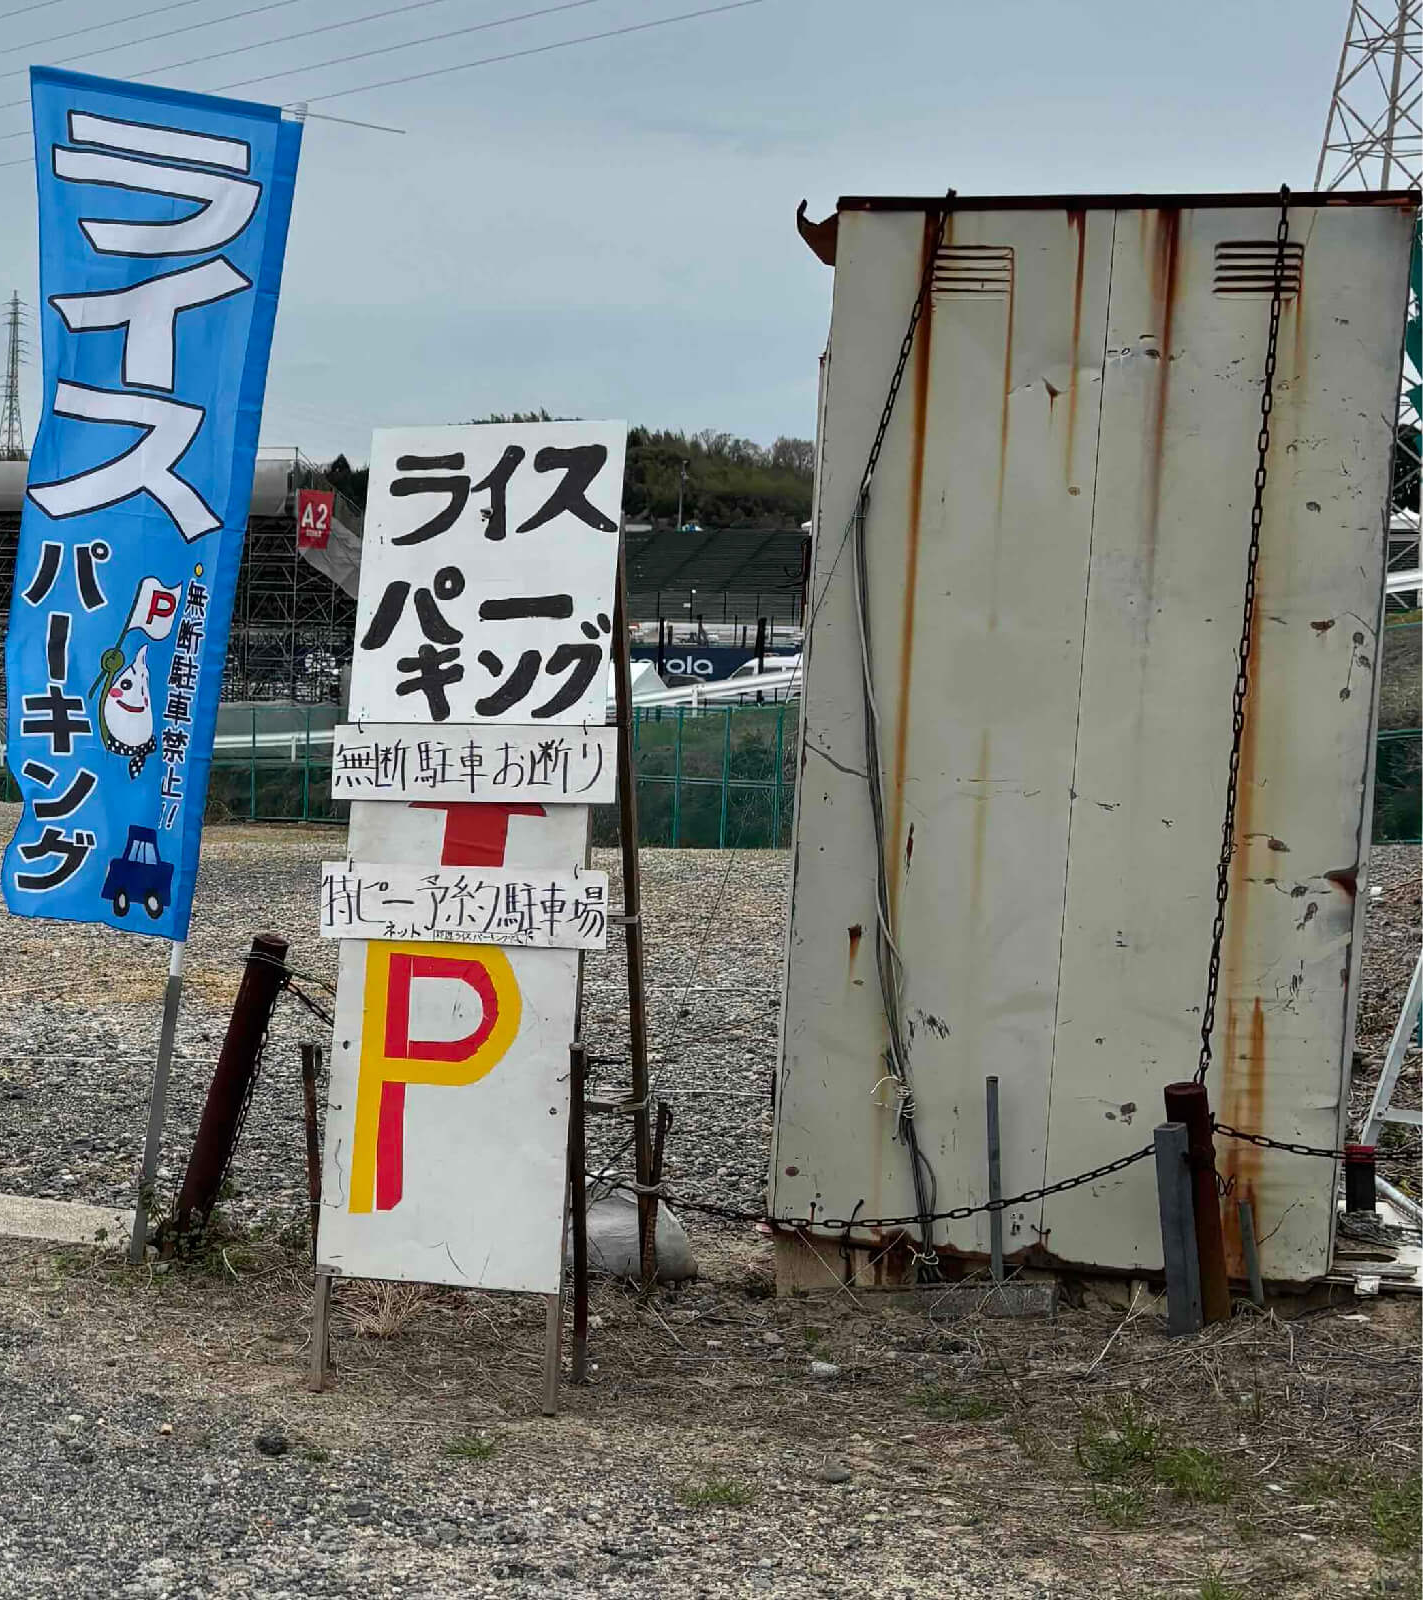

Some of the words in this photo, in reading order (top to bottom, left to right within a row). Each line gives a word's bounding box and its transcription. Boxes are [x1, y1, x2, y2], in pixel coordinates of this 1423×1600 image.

[25, 109, 264, 545] ライス
[301, 502, 328, 529] A2
[389, 444, 619, 546] ライス
[146, 590, 177, 624] P
[360, 565, 575, 651] パー
[395, 612, 613, 722] キング
[15, 538, 113, 894] パーキング
[334, 738, 604, 794] 無断駐車お断り
[321, 874, 606, 939] 特ピー予約駐車場
[382, 920, 422, 939] ネット
[347, 940, 524, 1215] P
